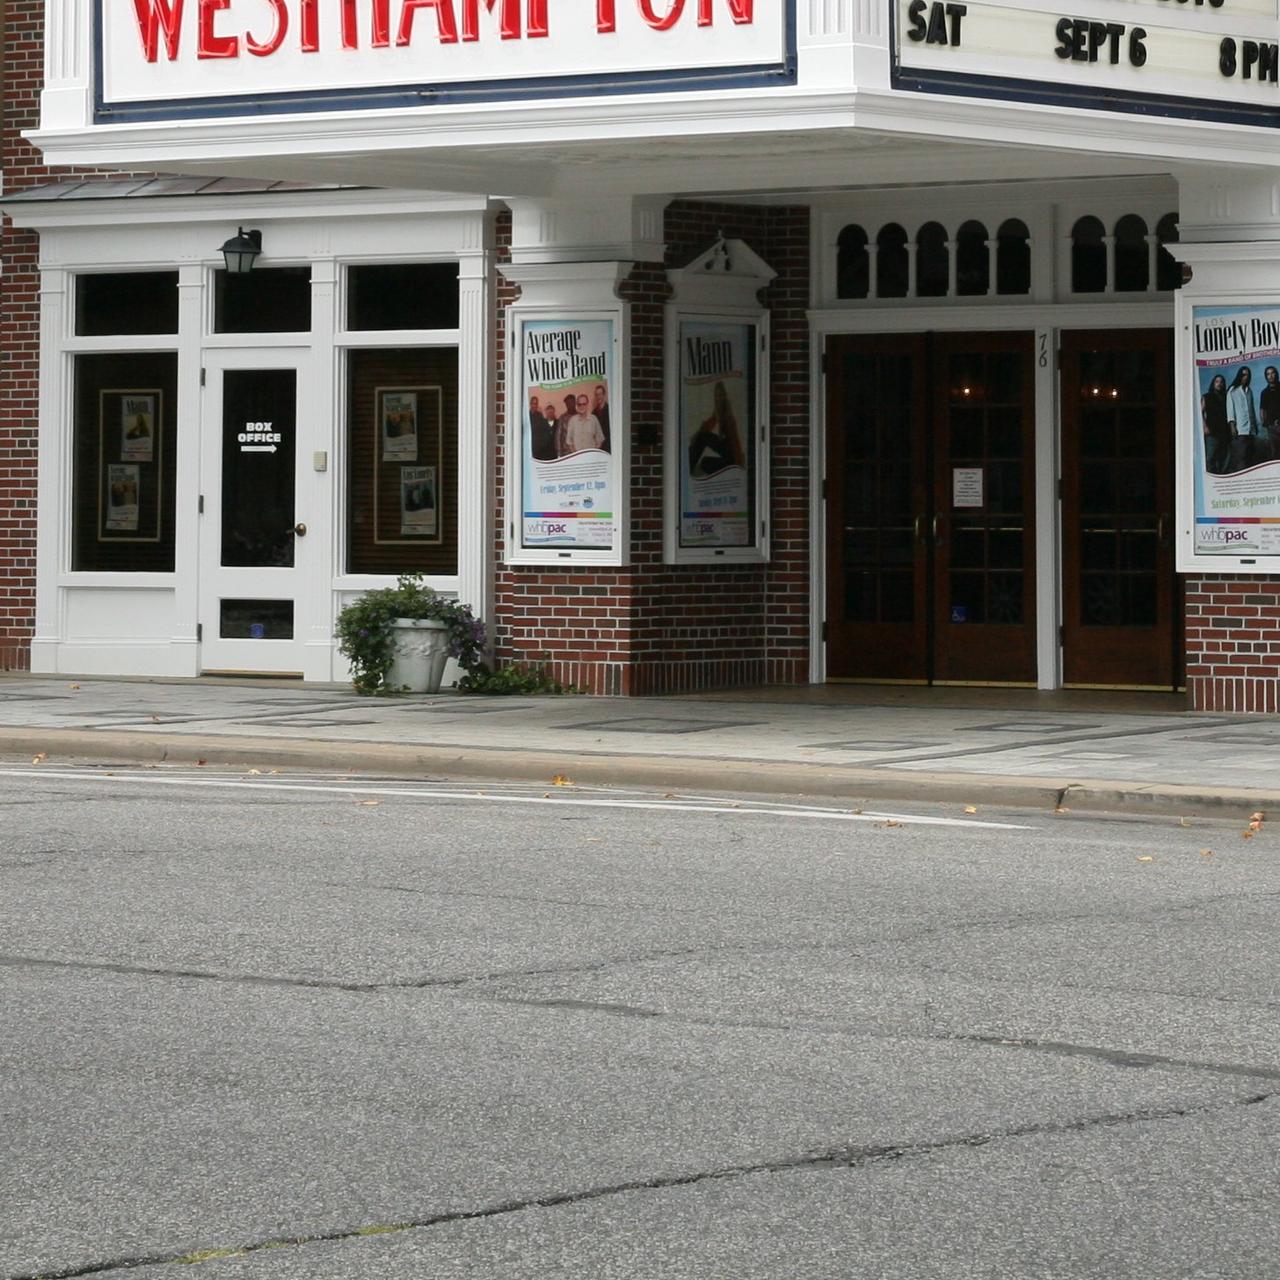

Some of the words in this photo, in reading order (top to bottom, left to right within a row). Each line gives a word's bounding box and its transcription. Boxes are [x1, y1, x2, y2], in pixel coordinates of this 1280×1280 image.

[907, 0, 967, 46] SAT
[1054, 17, 1126, 65] SEPT
[1129, 26, 1147, 67] 6
[1219, 36, 1237, 77] 8
[1242, 41, 1279, 83] PM
[527, 330, 581, 356] Average
[1039, 333, 1048, 368] 76
[1196, 320, 1247, 355] Lonely
[528, 357, 568, 382] White
[571, 351, 606, 378] Band
[687, 336, 732, 376] Mann
[237, 433, 281, 443] OFFICE
[246, 422, 273, 432] BOX
